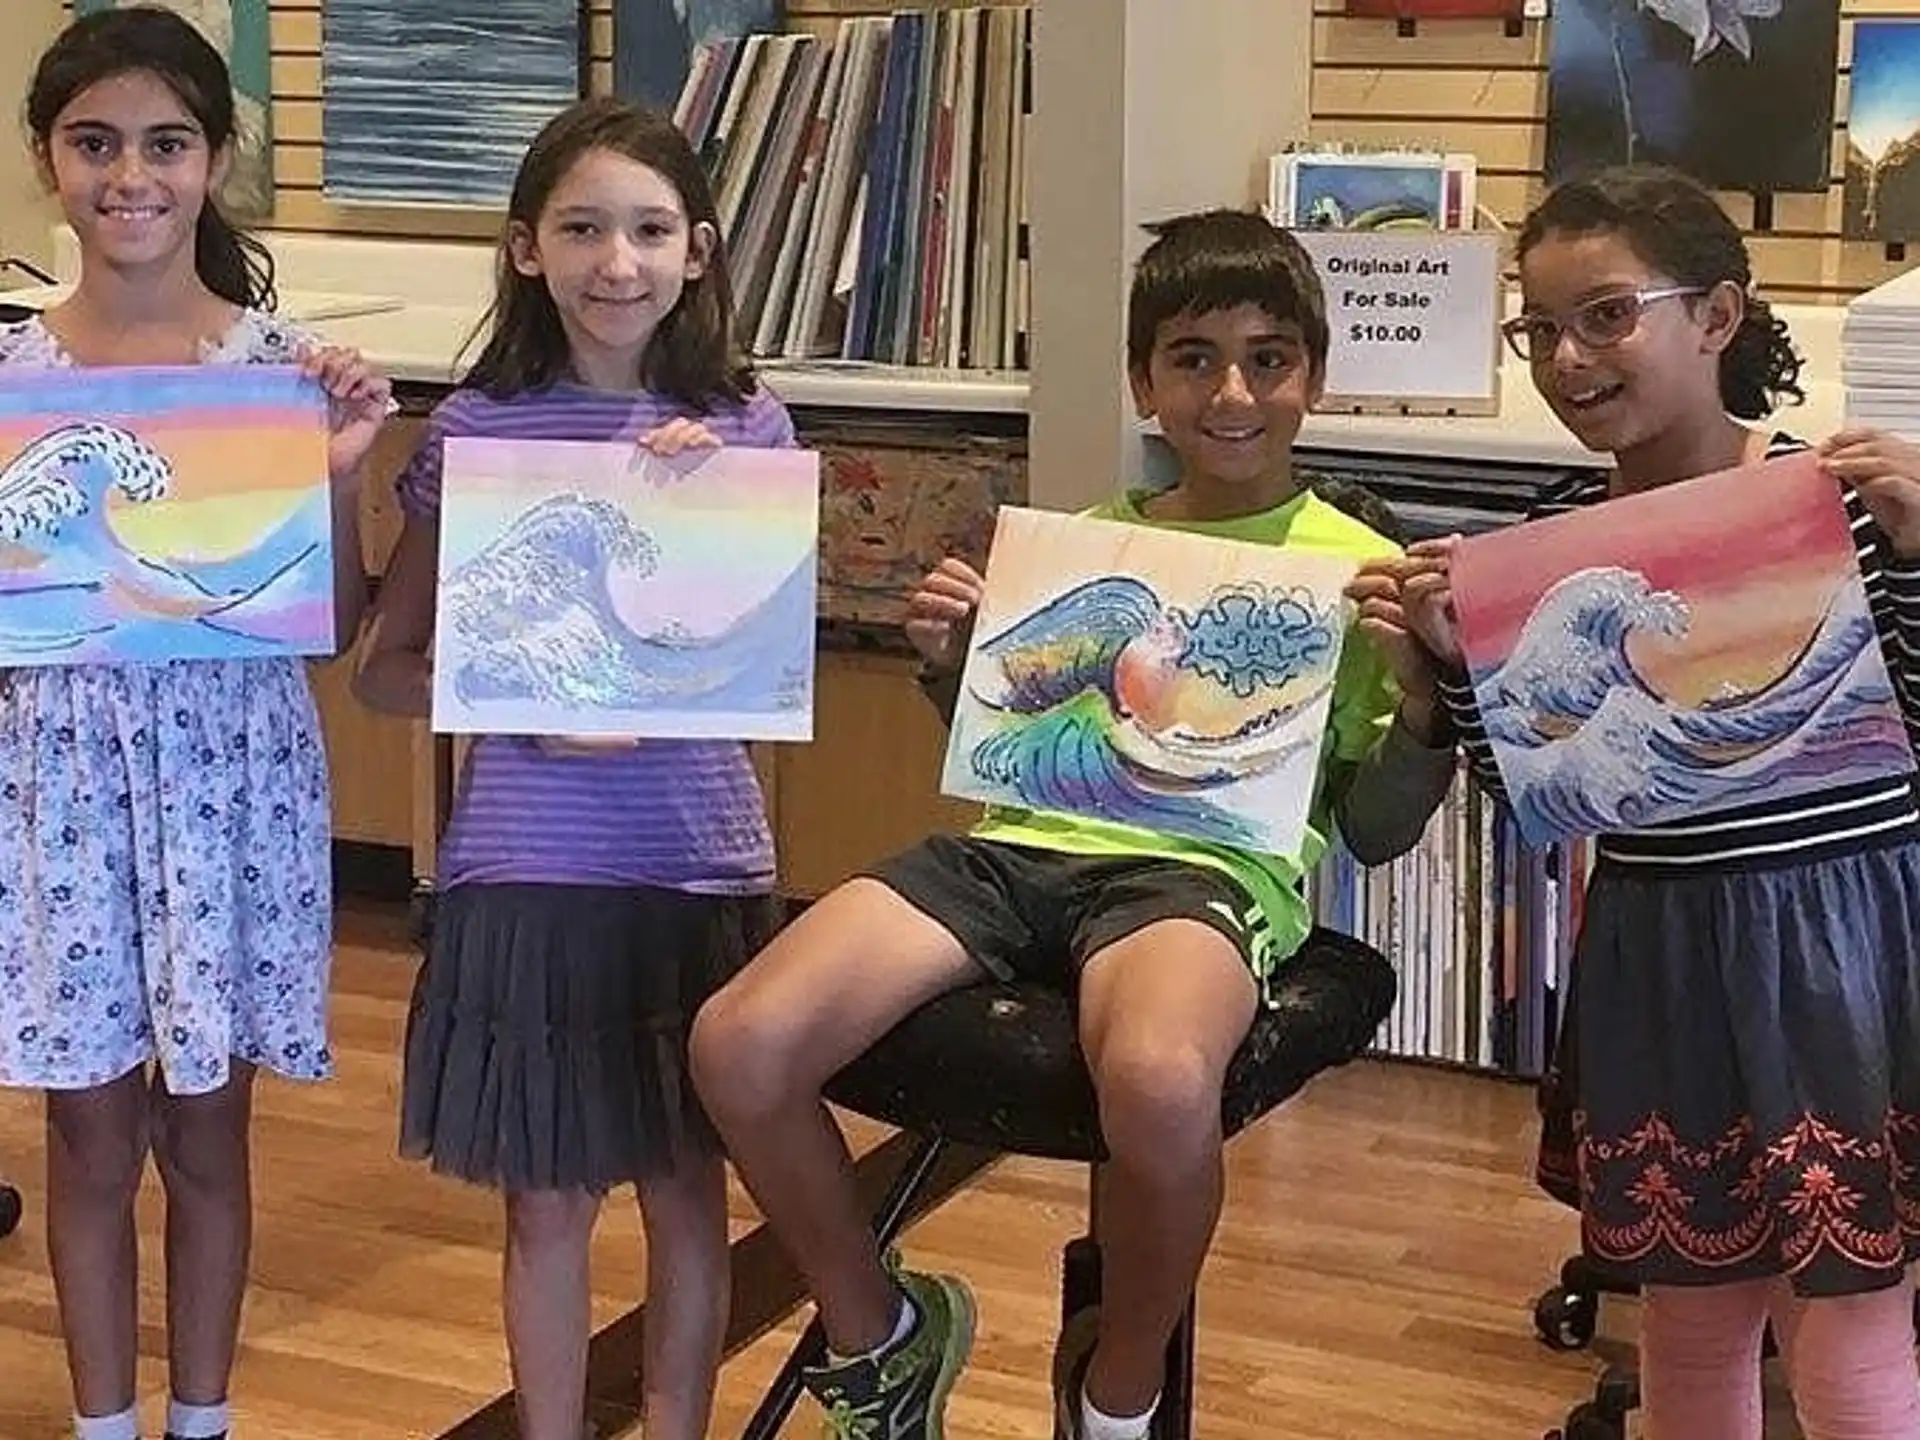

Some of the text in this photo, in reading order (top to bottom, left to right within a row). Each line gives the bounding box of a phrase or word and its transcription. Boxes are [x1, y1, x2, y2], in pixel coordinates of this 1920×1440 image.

[1328, 257, 1449, 276] Original Art
[1343, 291, 1431, 308] For Sale
[1350, 324, 1421, 341] $10.00
